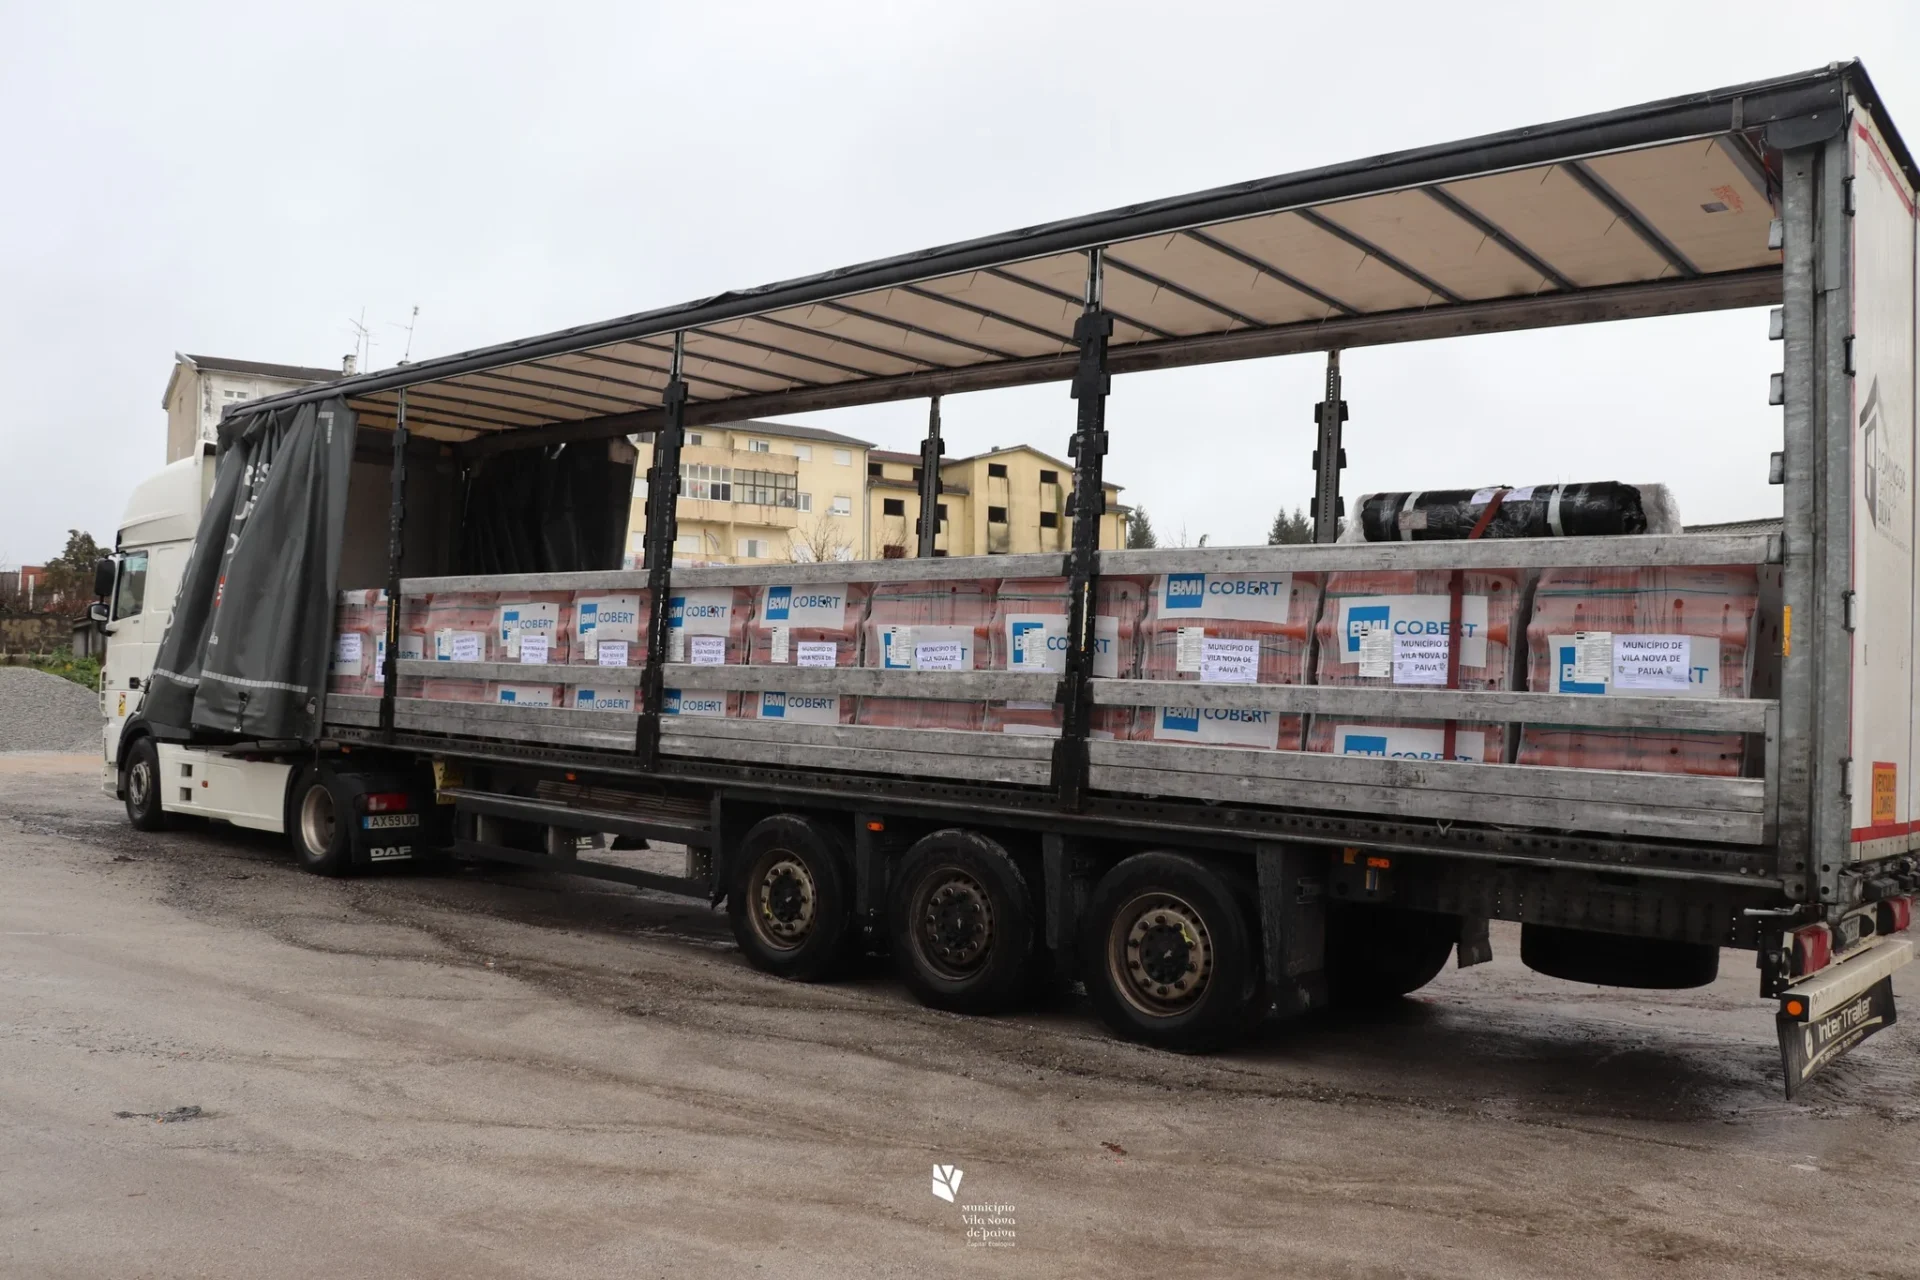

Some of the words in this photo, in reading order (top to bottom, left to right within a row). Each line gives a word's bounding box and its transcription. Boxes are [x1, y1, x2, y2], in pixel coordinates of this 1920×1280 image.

[1168, 579, 1203, 596] BMI
[1209, 580, 1283, 596] COBERT
[768, 596, 789, 610] BMI
[792, 595, 840, 609] COBERT
[685, 605, 727, 618] COBERT
[581, 612, 596, 624] BMI
[598, 612, 635, 624] COBERT
[520, 619, 554, 629] COBERT
[1401, 639, 1442, 648] MUNICÍPIO
[1622, 640, 1670, 650] MUNICÍPIO
[1671, 641, 1683, 650] DE
[1621, 654, 1640, 662] VILA
[1642, 654, 1667, 662] NOVA
[1669, 654, 1681, 663] DE
[1414, 663, 1437, 671] PAIVA
[1637, 667, 1664, 675] PAIVA
[595, 699, 630, 710] COBERT
[682, 700, 722, 712] COBERT
[764, 693, 785, 706] BMI
[788, 696, 835, 709] COBERT
[1204, 708, 1271, 724] COBERT
[370, 846, 412, 857] DAF
